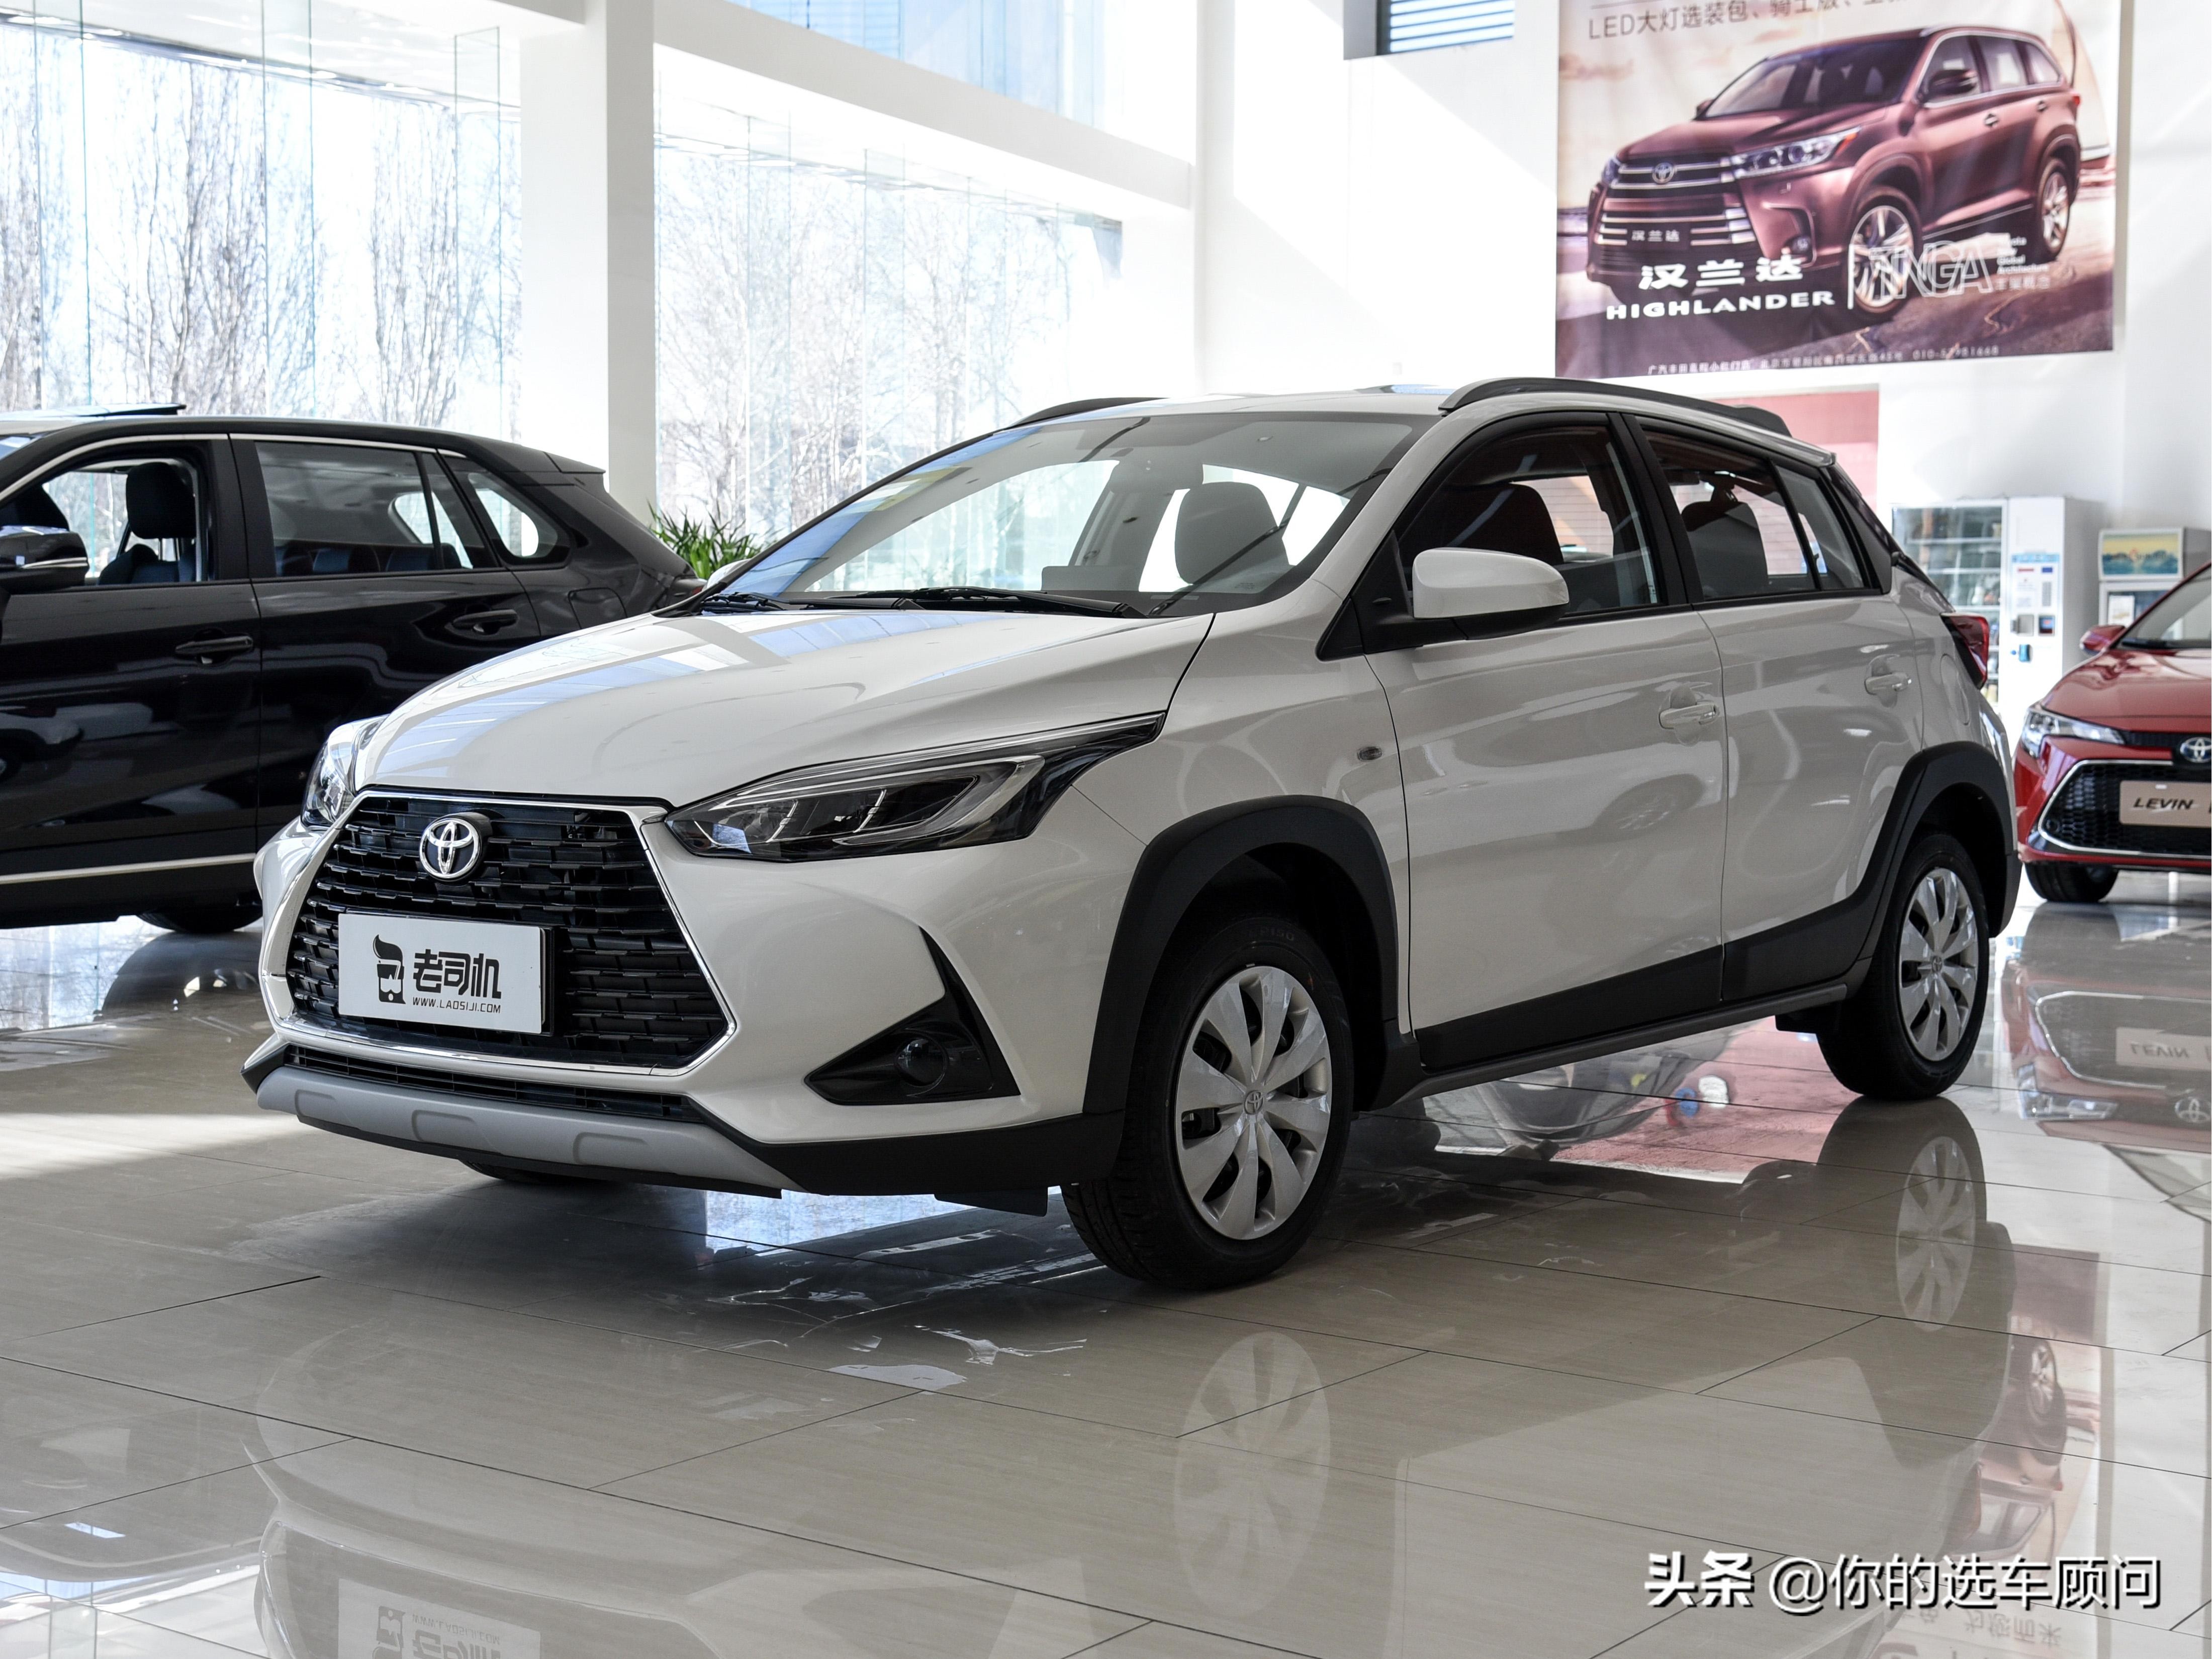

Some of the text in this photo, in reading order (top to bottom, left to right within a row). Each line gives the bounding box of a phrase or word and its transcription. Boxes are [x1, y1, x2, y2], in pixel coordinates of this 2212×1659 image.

[1631, 229, 1680, 242] 汉兰达
[1638, 254, 1803, 290] 汉兰达
[1606, 291, 1835, 320] HIGHLANDER
[2133, 797, 2194, 810] LEVIN
[413, 949, 502, 999] 老司机
[412, 996, 502, 1013] WWW.LAOSIJI.COM
